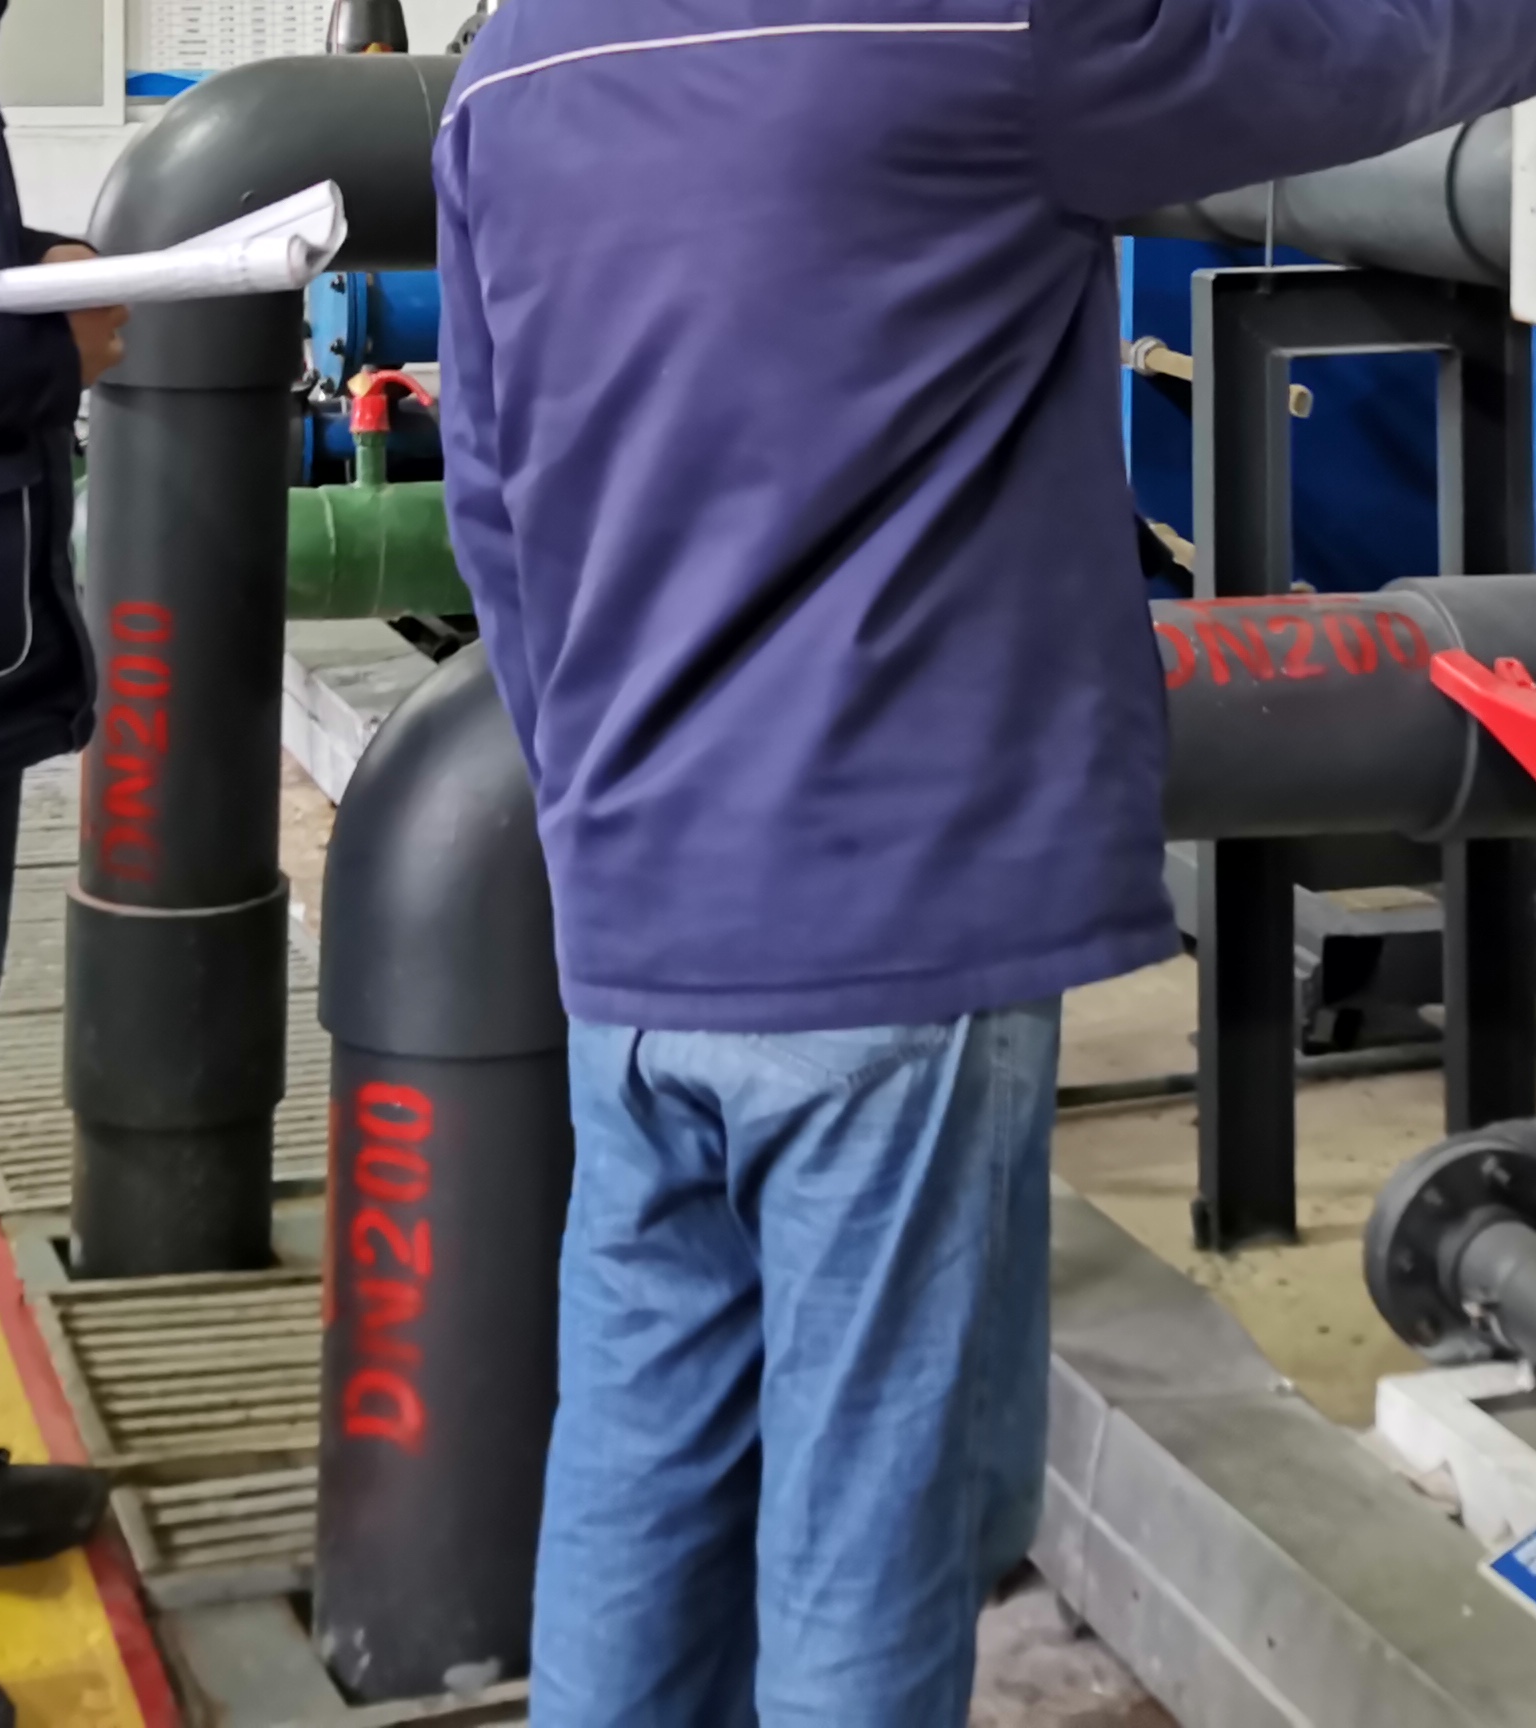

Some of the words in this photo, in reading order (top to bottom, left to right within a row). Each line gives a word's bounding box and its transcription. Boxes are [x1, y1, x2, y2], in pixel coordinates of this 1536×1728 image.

[98, 598, 176, 886] DN200
[1152, 611, 1433, 690] DN200
[344, 1080, 438, 1458] DN200
